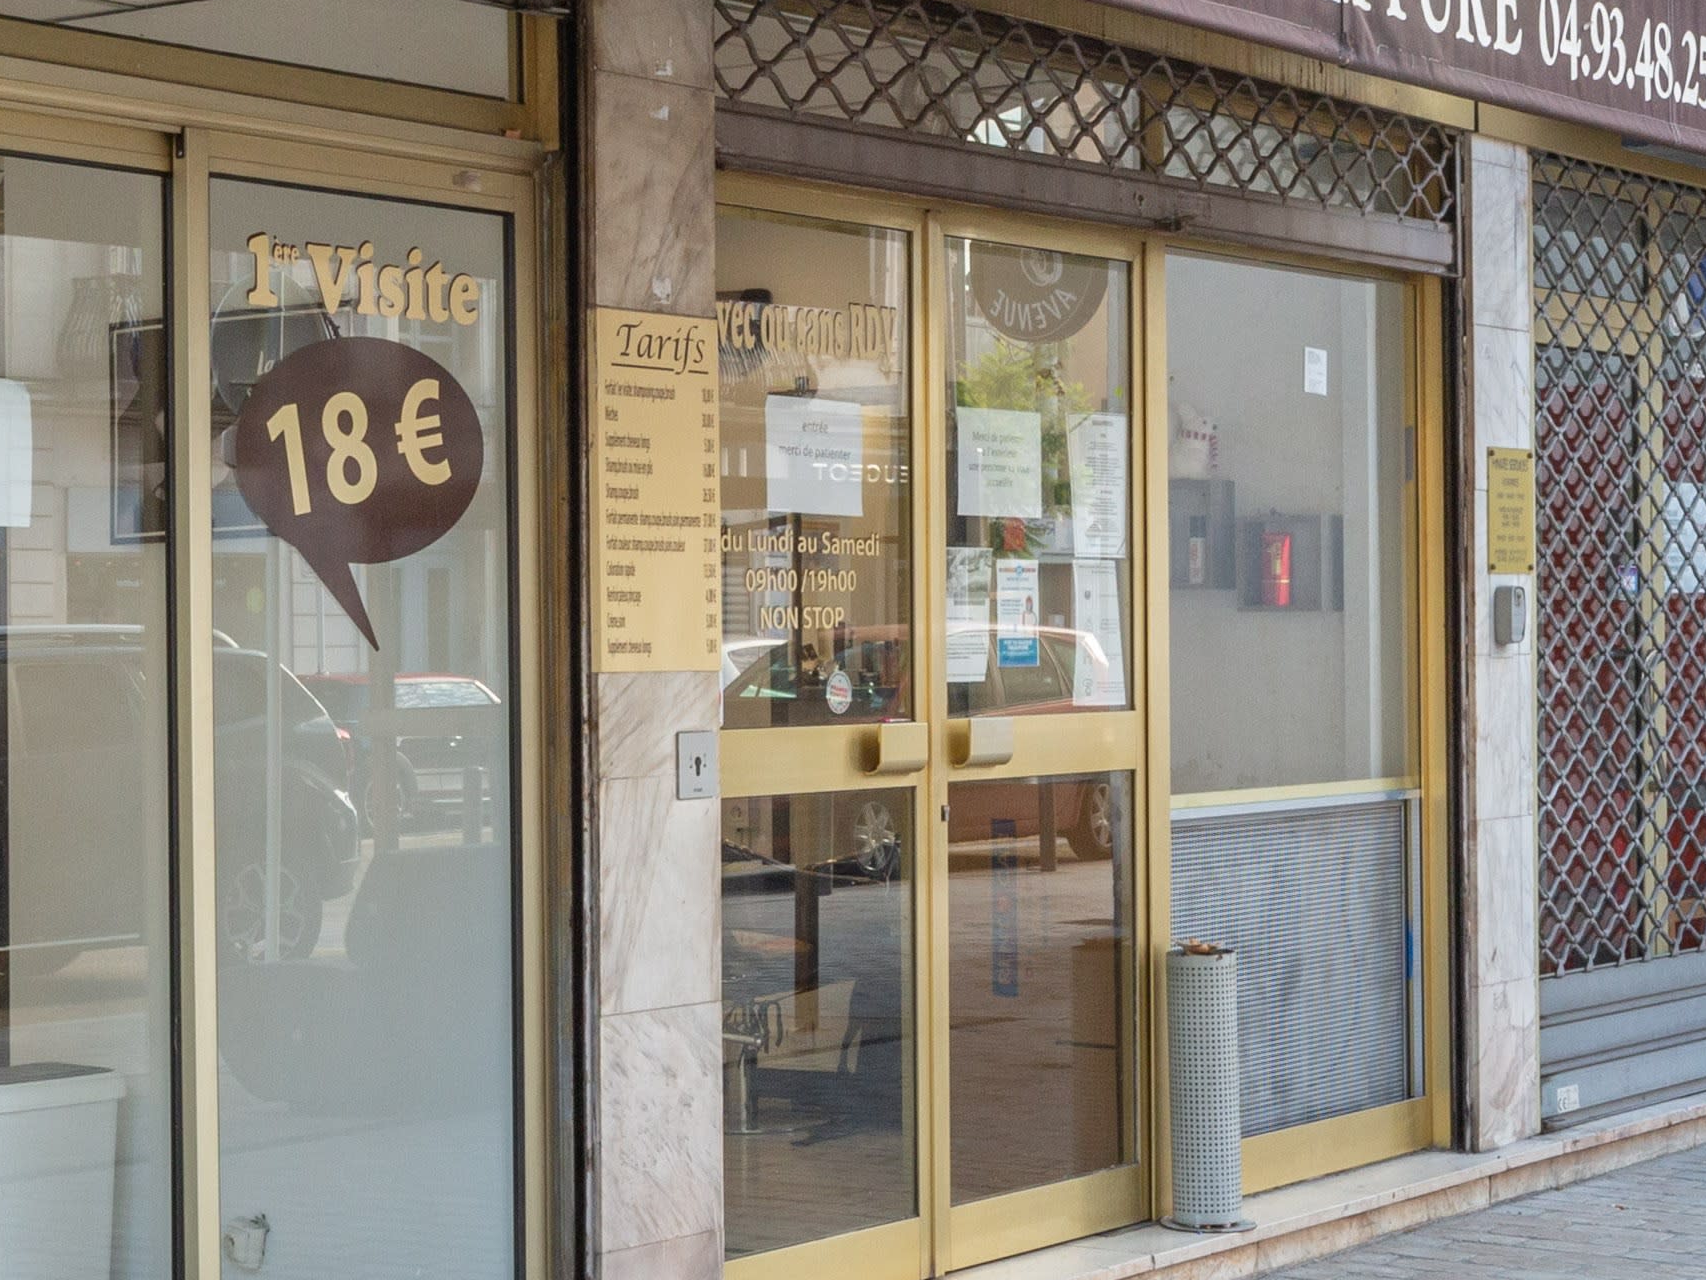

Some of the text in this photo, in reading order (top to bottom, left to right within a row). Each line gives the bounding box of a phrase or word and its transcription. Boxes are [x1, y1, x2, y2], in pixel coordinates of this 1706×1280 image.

[304, 239, 481, 326] Visite
[760, 304, 791, 354] ou
[848, 302, 898, 361] RDV
[615, 320, 706, 375] Tarifs
[801, 421, 830, 434] entrée
[265, 377, 453, 517] 18 €
[802, 446, 814, 458] de
[720, 528, 743, 553] du
[747, 528, 794, 553] Lundi
[797, 535, 818, 554] au
[821, 531, 881, 557] Samedi
[745, 569, 799, 593] 09h00
[760, 605, 845, 630] NON STOP
